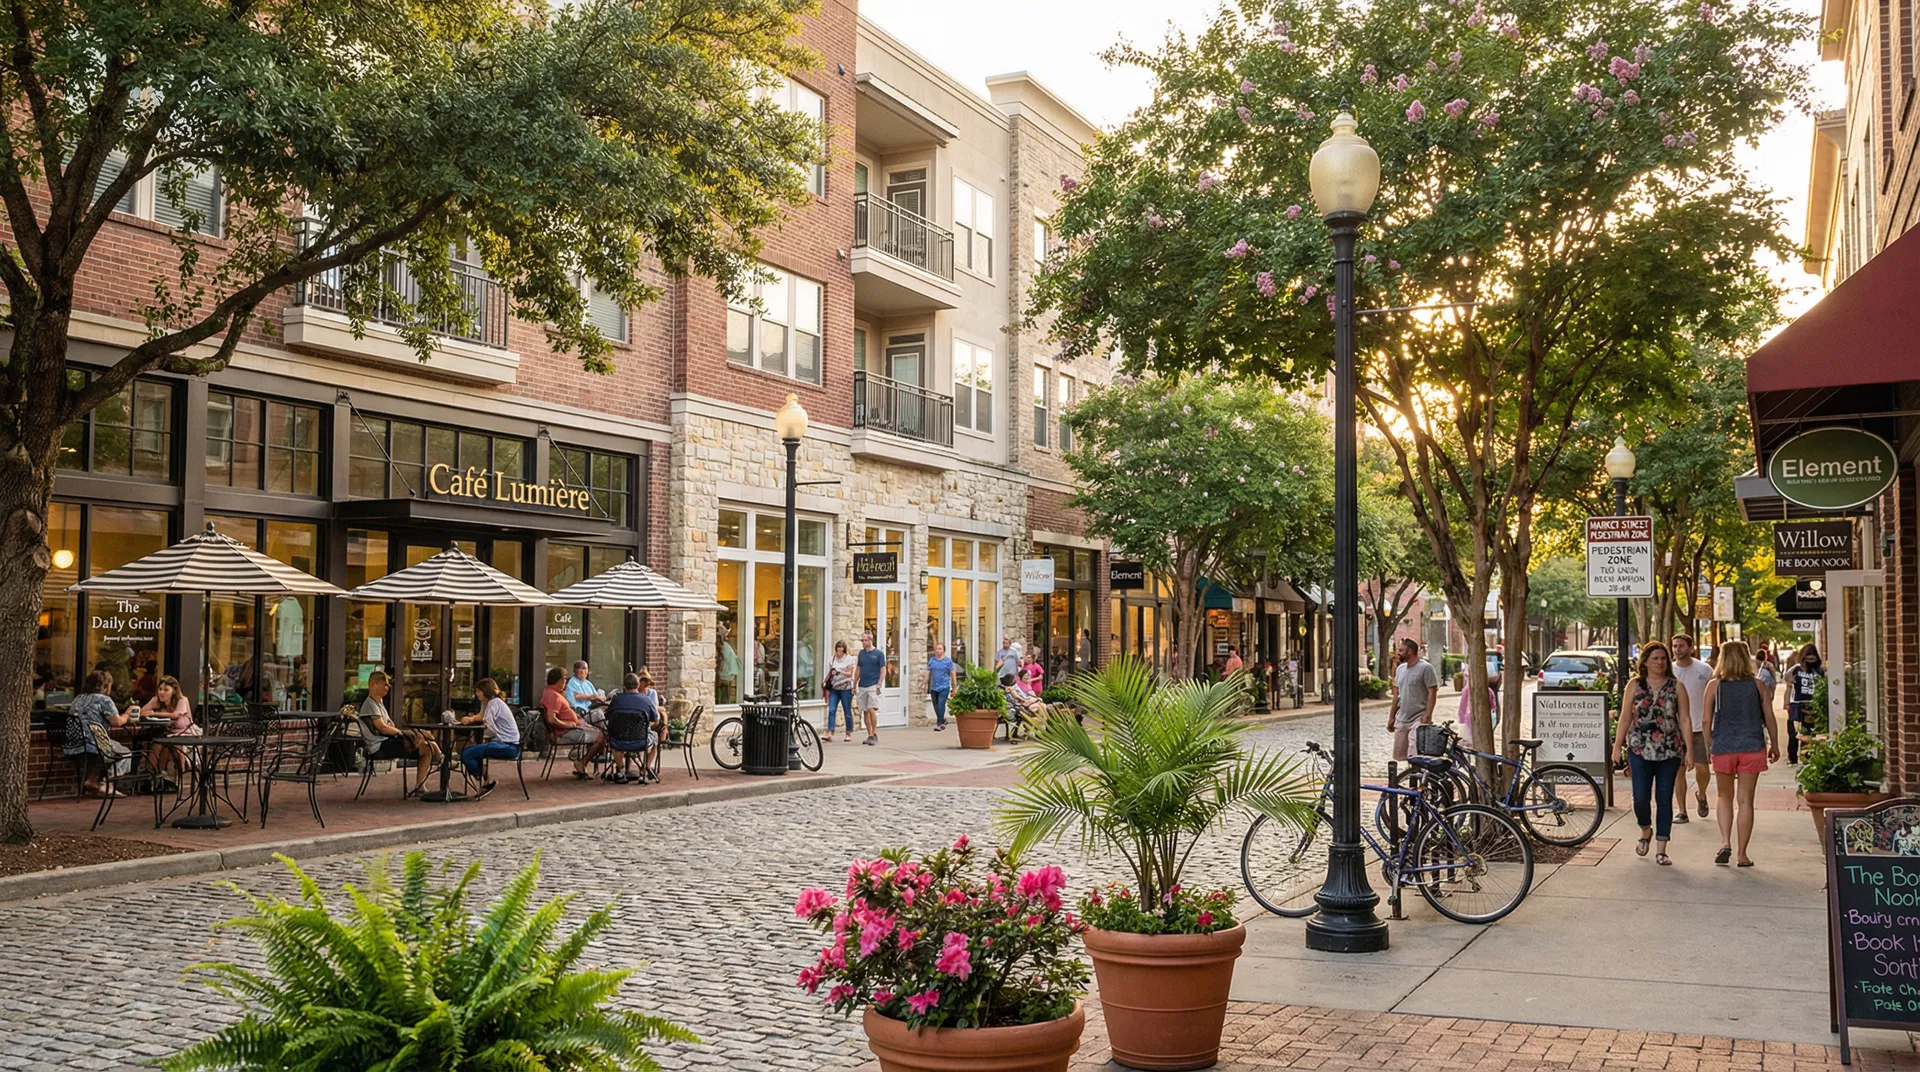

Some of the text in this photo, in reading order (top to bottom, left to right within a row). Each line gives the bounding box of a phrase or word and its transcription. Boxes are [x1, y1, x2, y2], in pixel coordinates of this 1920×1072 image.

[1782, 456, 1882, 478] Element
[430, 463, 589, 511] Café Lumière
[1777, 530, 1847, 548] Willow
[1591, 546, 1648, 555] PEDESTRIAN
[1607, 556, 1633, 564] ZONE
[1776, 557, 1851, 567] THE BOOK NOOK
[116, 600, 140, 613] The
[92, 616, 163, 632] Daily Grind
[1844, 865, 1920, 886] The Bo
[1854, 932, 1905, 951] Book
